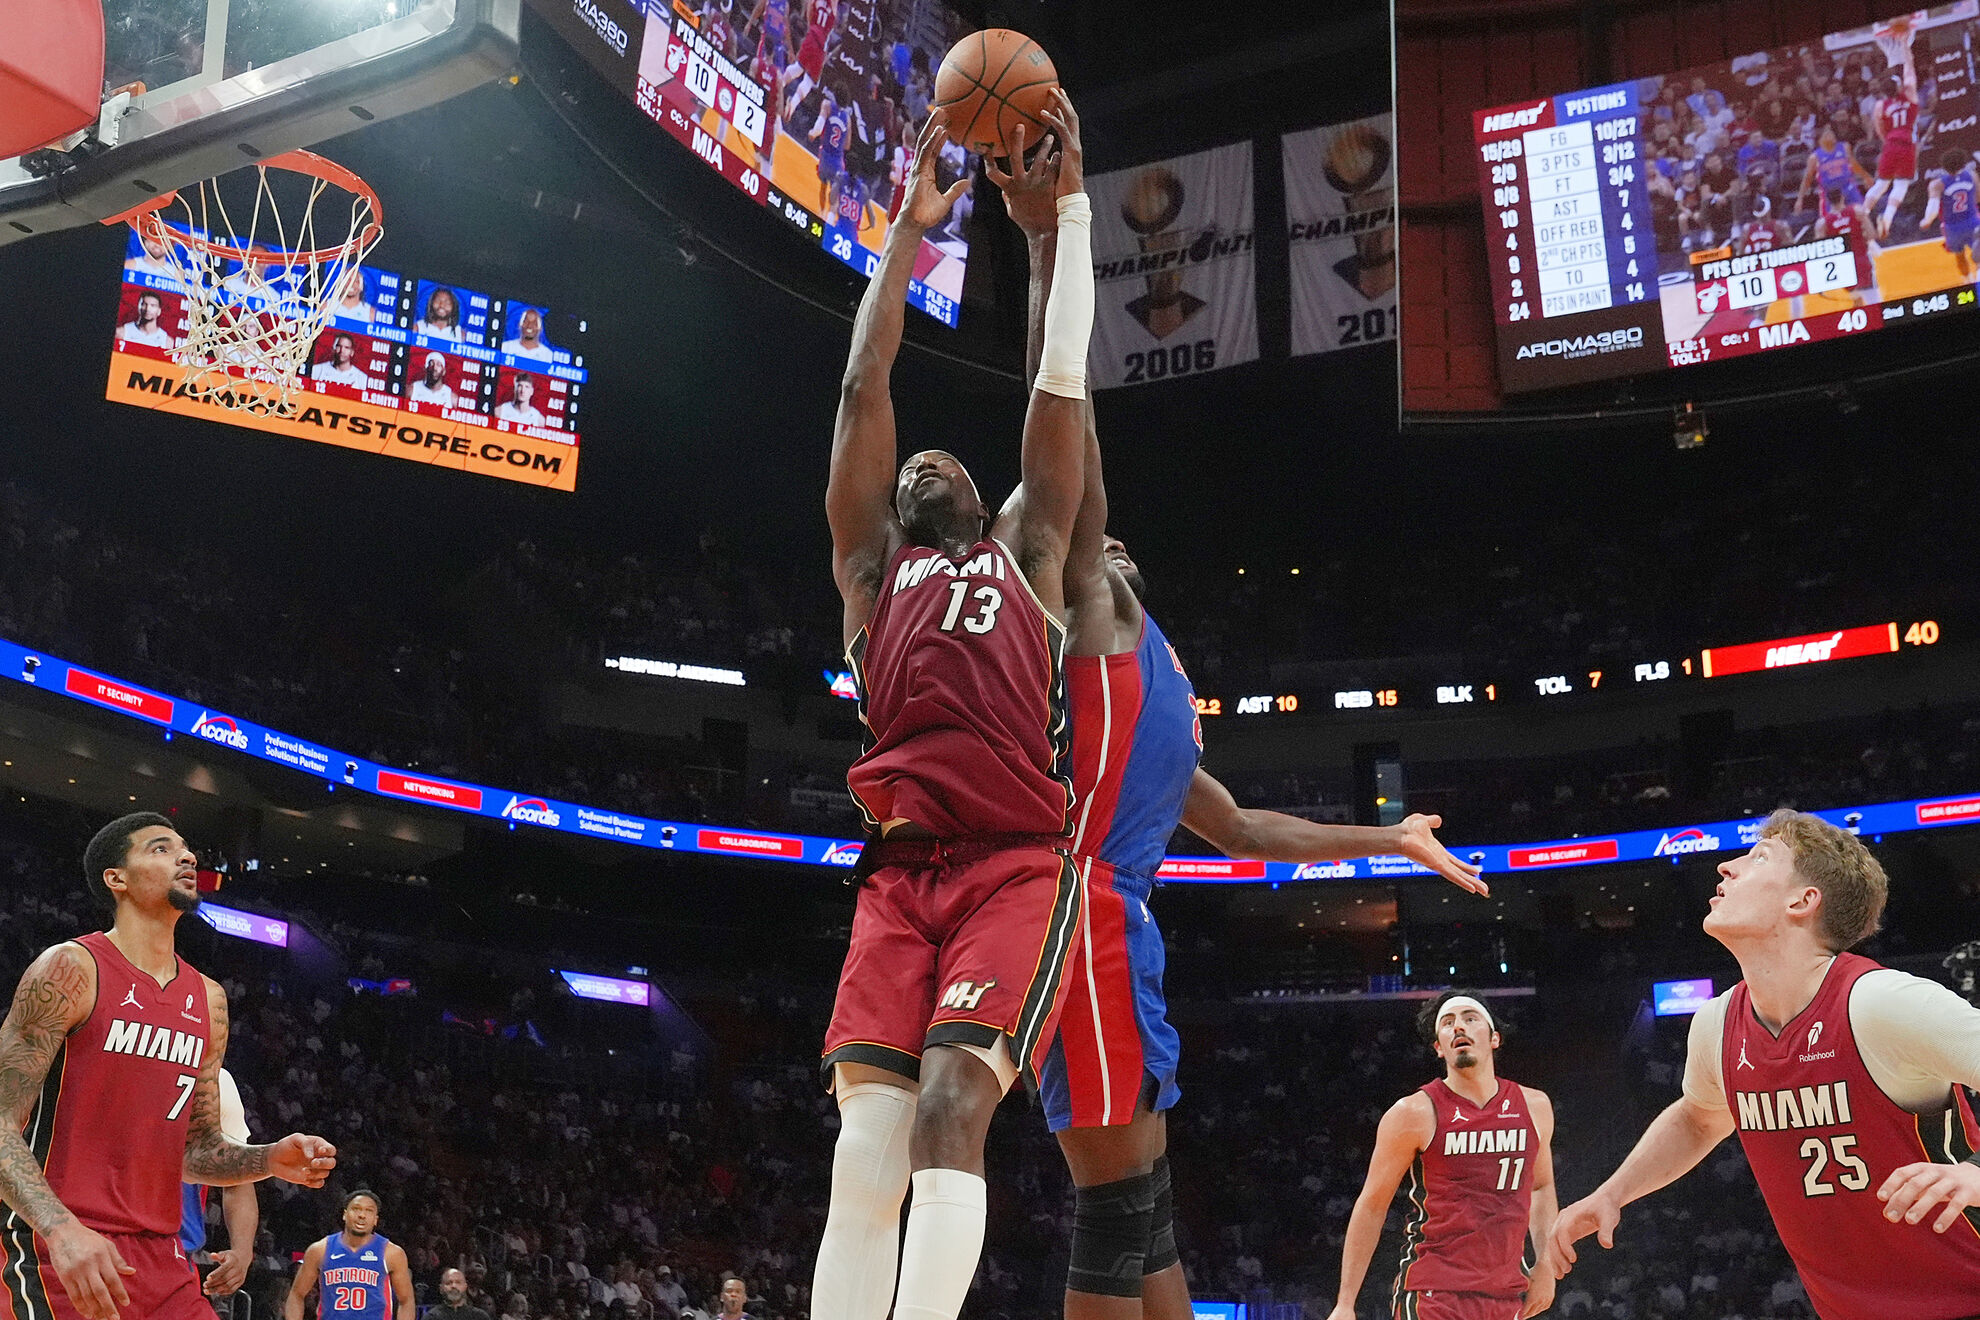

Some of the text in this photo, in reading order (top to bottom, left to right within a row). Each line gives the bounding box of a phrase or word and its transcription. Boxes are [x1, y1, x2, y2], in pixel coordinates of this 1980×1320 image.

[677, 18, 765, 107] PTS OFF TURNOVERS
[695, 63, 709, 93] 10
[1565, 90, 1627, 117] PISTONS
[744, 106, 753, 130] 2
[1482, 101, 1547, 133] HEAT
[1550, 132, 1567, 148] FG
[1594, 116, 1637, 142] 10/27
[691, 127, 724, 171] MIA
[1603, 140, 1636, 164] 3/12
[1541, 152, 1581, 172] 3 PTS
[740, 168, 759, 196] 40
[1555, 177, 1571, 193] FT
[1608, 164, 1635, 187] 3/4
[1553, 200, 1579, 217] AST
[1618, 189, 1630, 208] 7
[785, 202, 808, 229] 8:45
[1290, 207, 1396, 241] CHAMPI
[1499, 209, 1519, 229] 10
[1620, 212, 1634, 231] 4
[811, 222, 822, 238] 24
[1540, 219, 1598, 243] OFF REB
[832, 233, 852, 260] 26
[1505, 232, 1518, 251] 4
[1623, 234, 1636, 254] 5
[1561, 247, 1577, 264] CH
[1579, 242, 1601, 260] PTS
[1702, 260, 1732, 281] PTS
[1731, 254, 1759, 275] OFF
[1759, 236, 1846, 270] TURNOVERS
[1566, 269, 1583, 286] TO
[1626, 258, 1639, 278] 4
[1825, 262, 1838, 282] 2
[1510, 278, 1524, 298] 2
[1625, 281, 1645, 302] 14
[1740, 277, 1763, 300] 10
[1957, 290, 1975, 305] 24
[377, 293, 395, 307] AST
[1913, 294, 1950, 316] 8:45
[468, 314, 486, 327] AST
[1508, 301, 1531, 322] 24
[1837, 309, 1868, 332] 40
[491, 336, 497, 348] 1
[1516, 326, 1643, 361] AROMA360
[1758, 320, 1811, 349] MIA
[118, 341, 126, 352] 7
[396, 346, 404, 358] 4
[369, 359, 388, 373] AST
[485, 366, 496, 378] 11
[1124, 339, 1216, 384] 2006
[460, 379, 478, 393] AST
[482, 402, 490, 413] 4
[547, 398, 566, 411] AST
[940, 580, 1003, 635] 13
[1903, 620, 1940, 646] 40
[1765, 631, 1843, 669] HEAT
[1635, 658, 1693, 682] FLS 1
[1437, 684, 1496, 704] BLK 1
[1535, 671, 1602, 696] TOL 7
[97, 684, 143, 707] IT SECURITY
[1237, 695, 1297, 715] AST 10
[1335, 689, 1397, 710] REB 15
[191, 710, 249, 750] Acordis
[264, 733, 329, 763] Preferred Business
[265, 745, 326, 774] Solutions Partner
[403, 781, 455, 799] NETWORKING
[501, 795, 560, 827] Acordis
[579, 819, 643, 840] Solutions Partner
[613, 815, 646, 831] Business
[719, 836, 782, 851] COLLABORATION
[1653, 832, 1720, 857] Acordis
[1528, 847, 1588, 863] DATA SECURITY
[1291, 861, 1356, 880] Acordis
[103, 1018, 204, 1069] MIAMI
[1799, 1050, 1835, 1063] Robinhood
[166, 1073, 197, 1121] 7
[1735, 1079, 1853, 1132] MIAMI
[1443, 1128, 1527, 1156] MIAMI
[1496, 1157, 1525, 1191] 11
[1799, 1133, 1871, 1198] 25
[323, 1266, 380, 1287] DETROIT
[334, 1286, 366, 1311] 20
